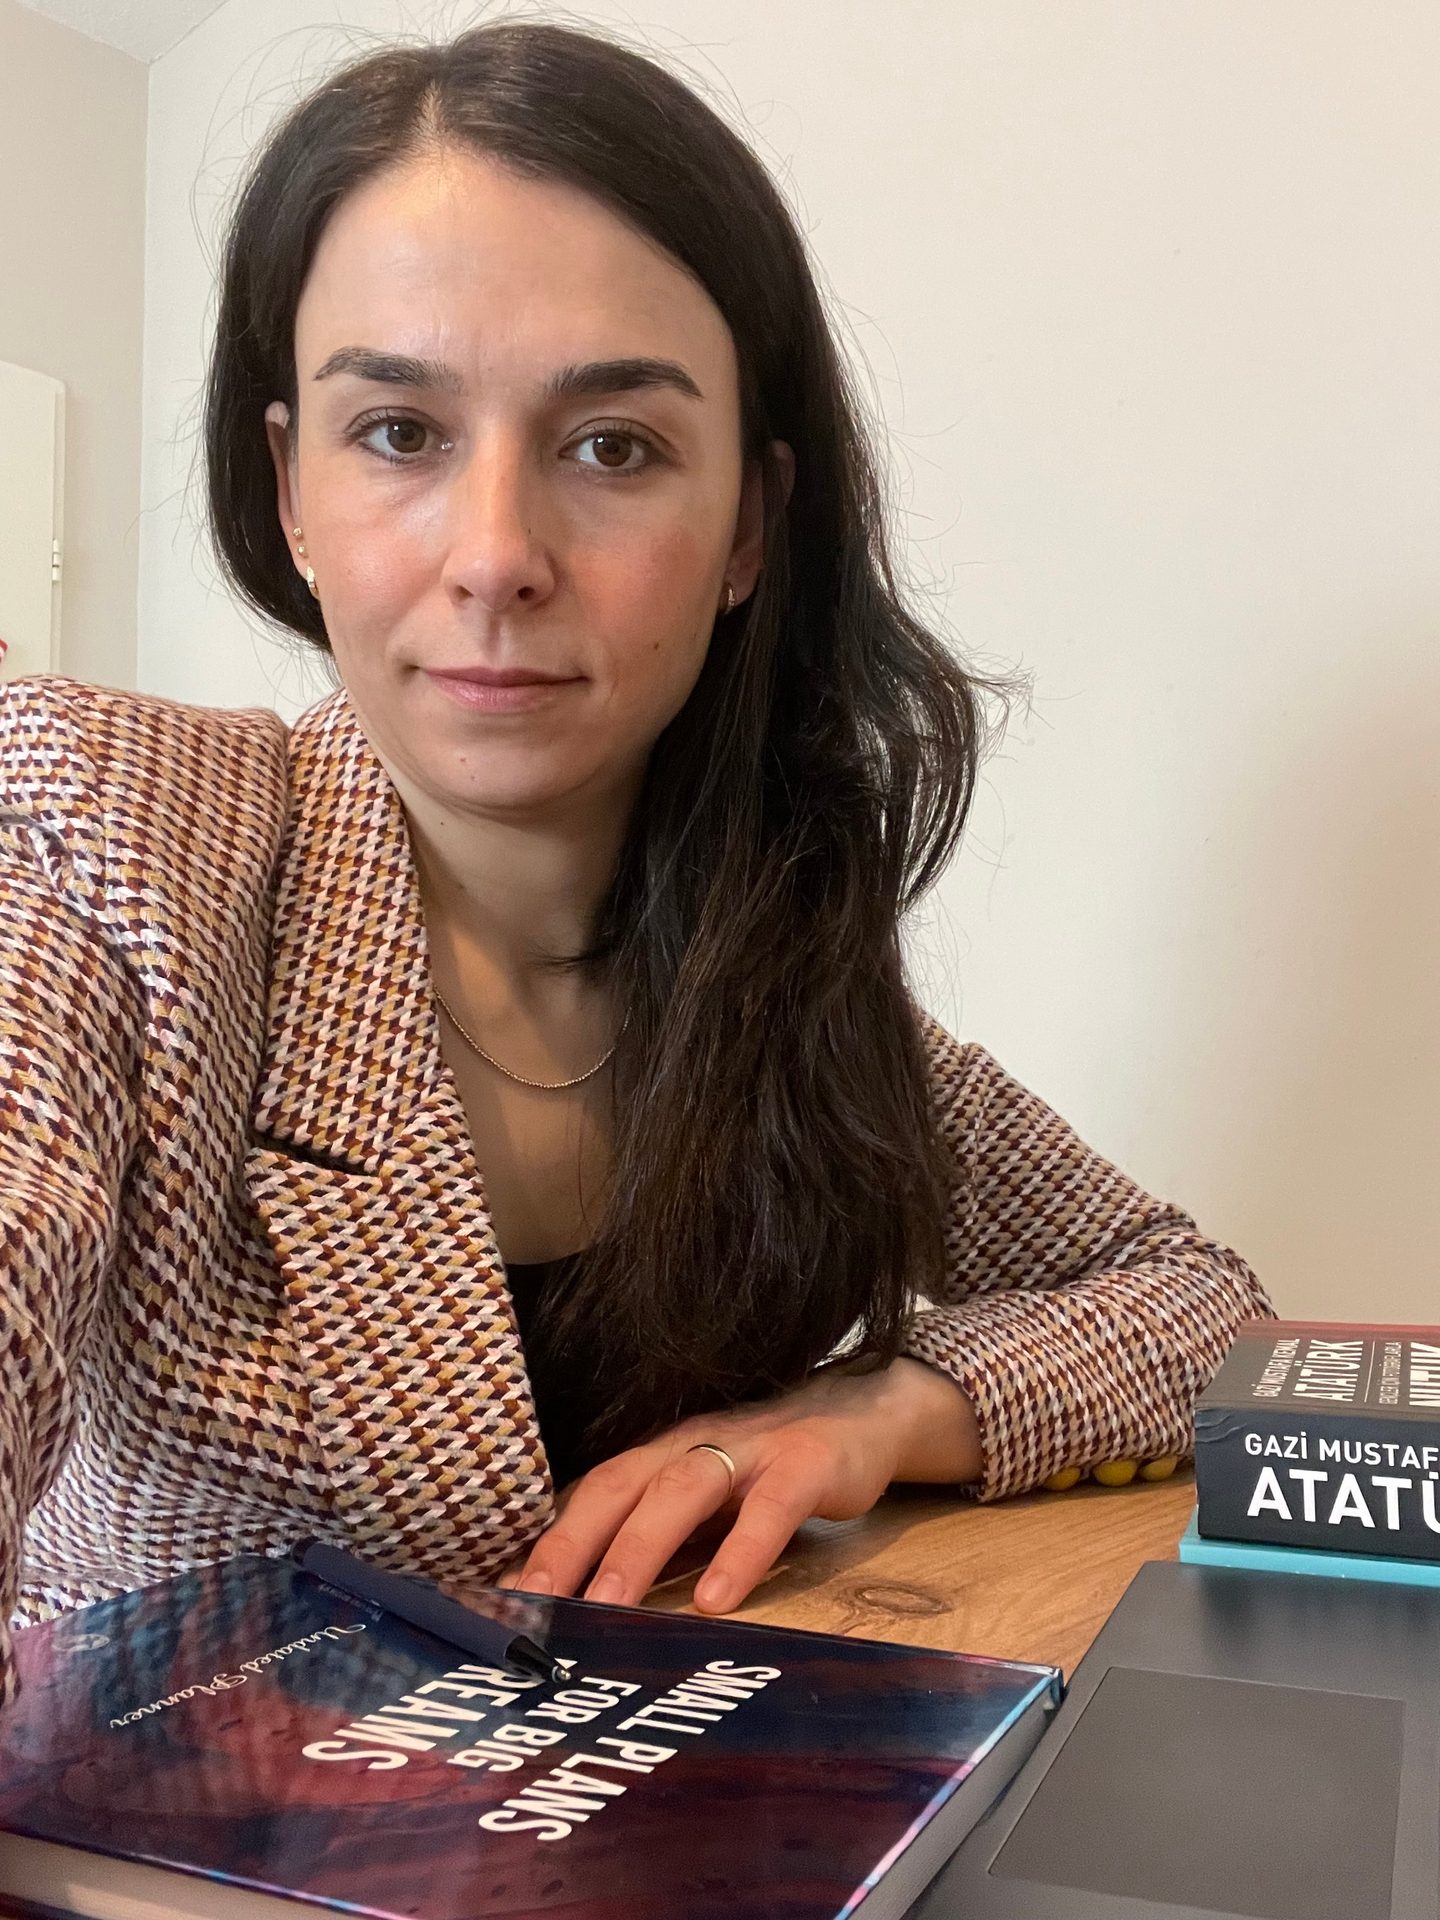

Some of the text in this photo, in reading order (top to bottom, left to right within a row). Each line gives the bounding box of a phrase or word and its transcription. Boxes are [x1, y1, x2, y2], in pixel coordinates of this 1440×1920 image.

[1292, 1339, 1364, 1402] ATATÜRK
[1245, 1431, 1308, 1460] GAZİ
[110, 1624, 366, 1729] Undated Planner
[302, 1658, 577, 1772] REAMS
[447, 1675, 642, 1774] FOR BIG
[478, 1659, 782, 1842] SMALL PLANS
